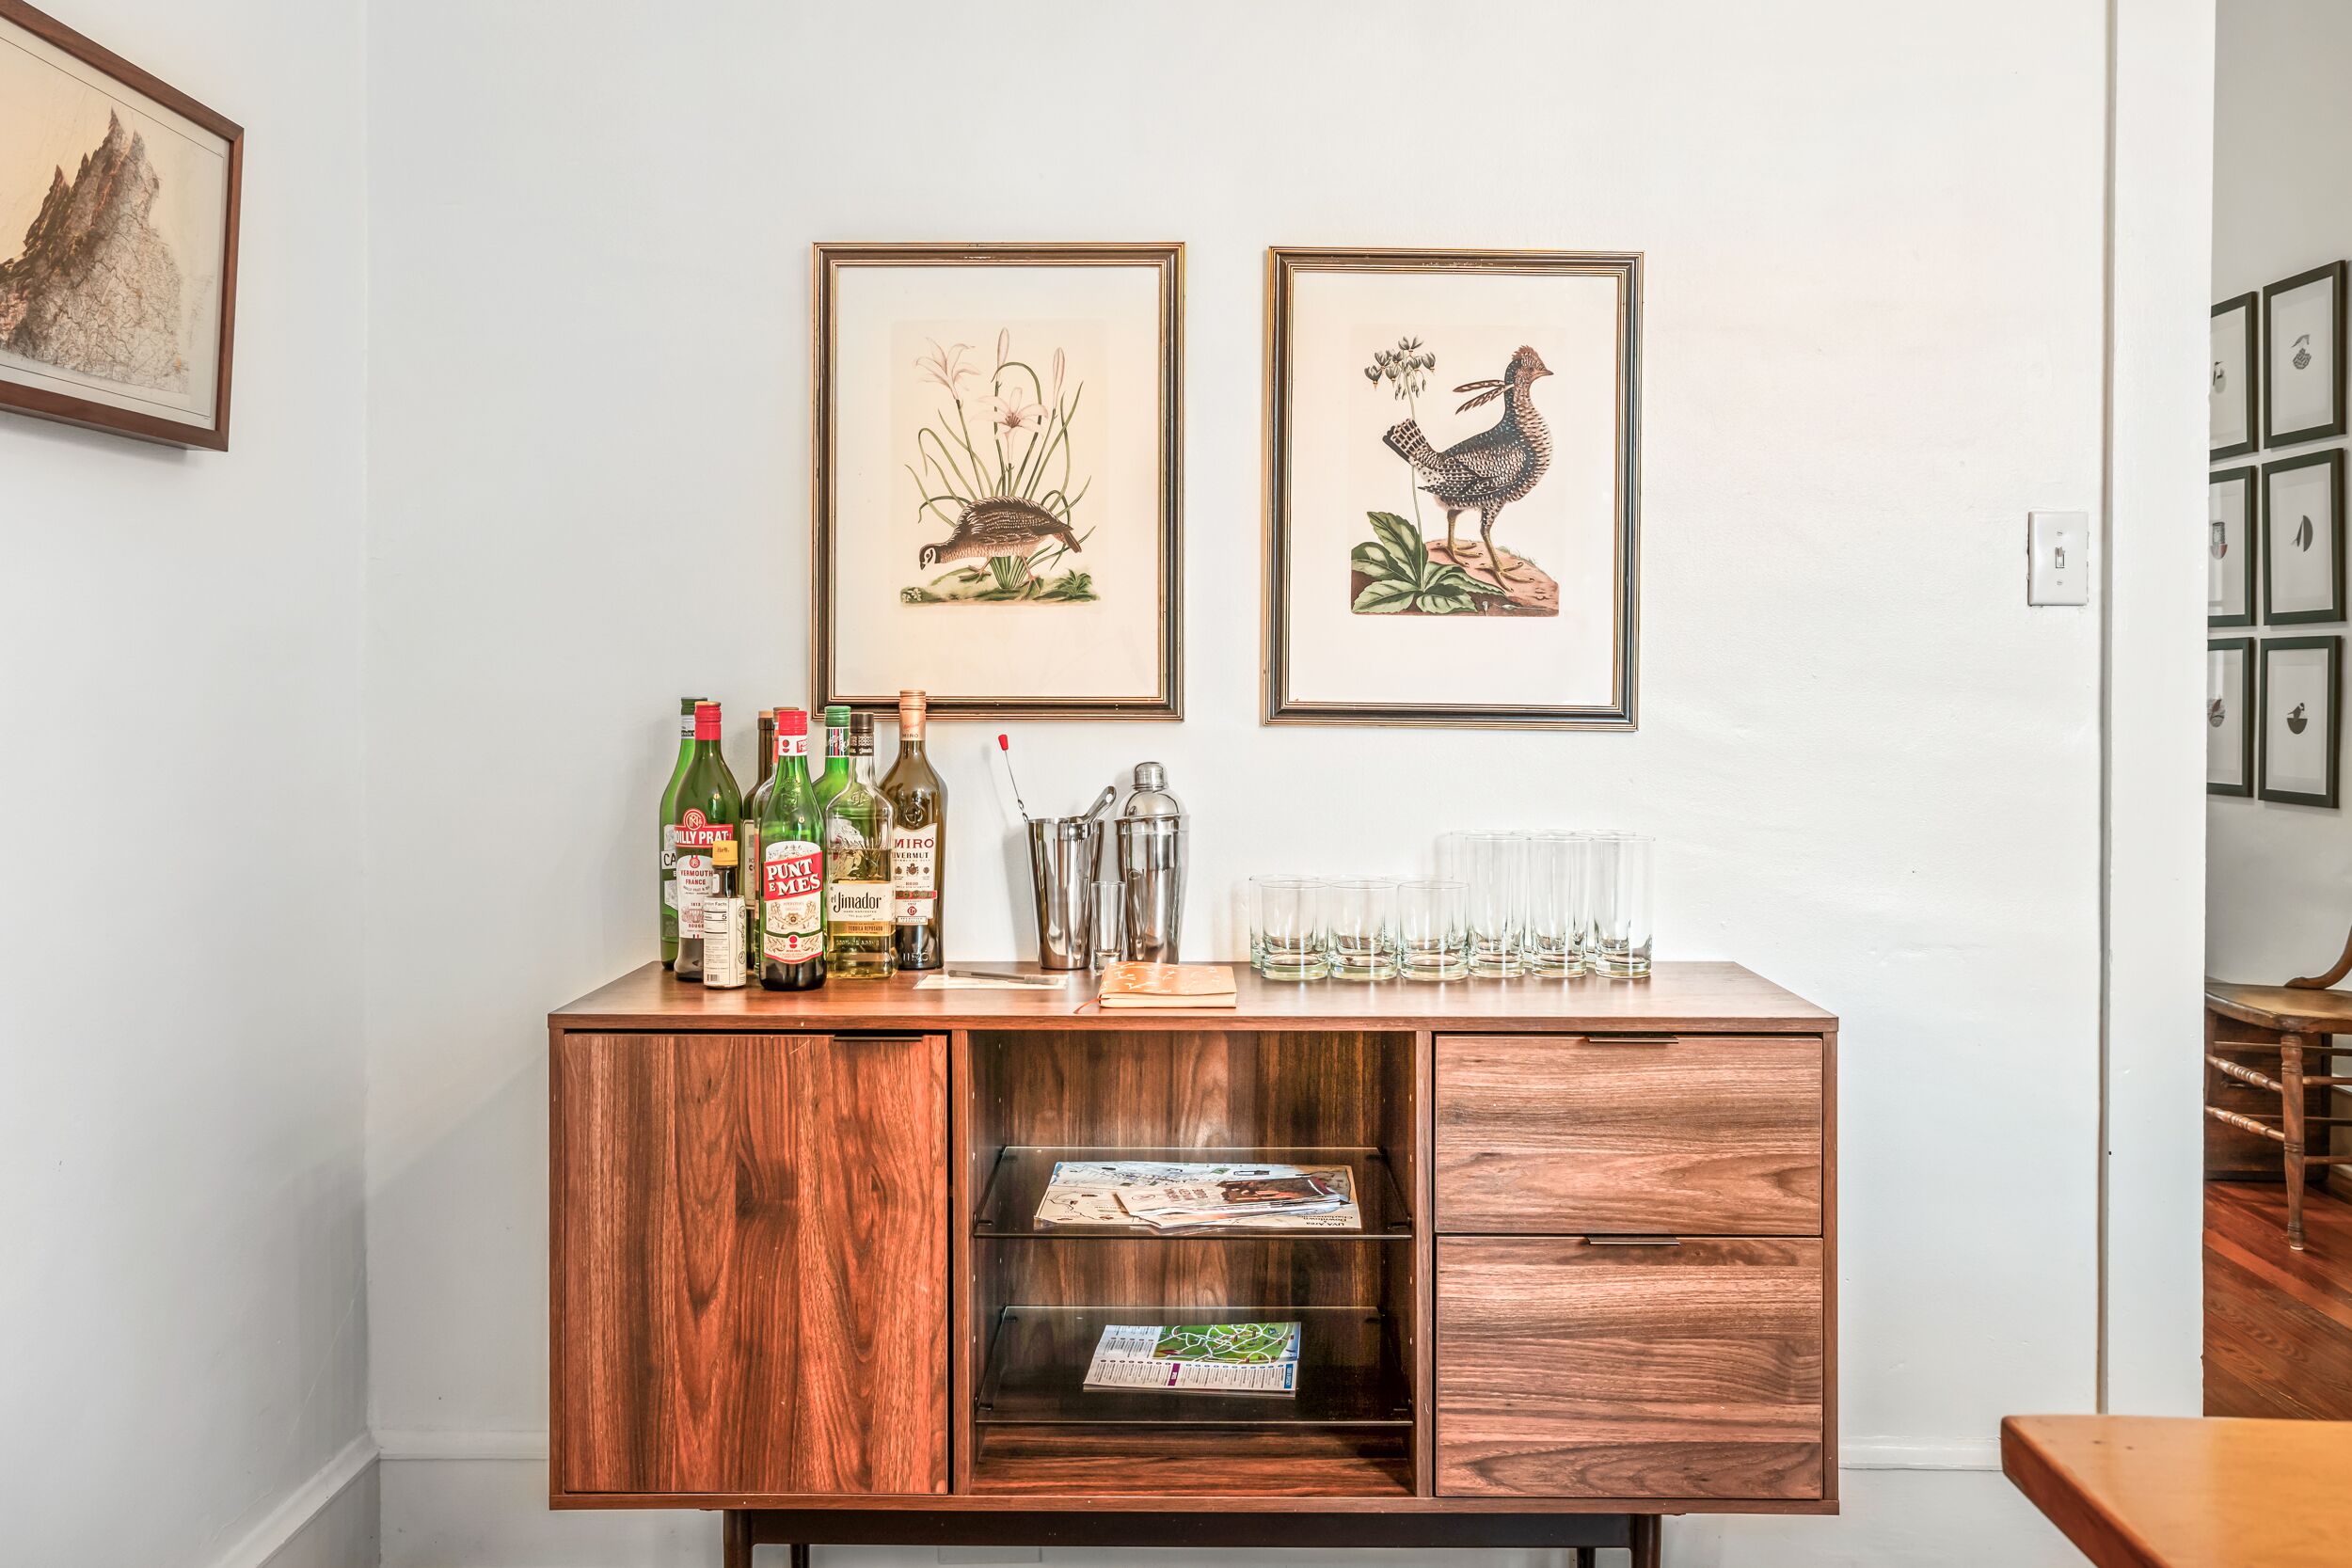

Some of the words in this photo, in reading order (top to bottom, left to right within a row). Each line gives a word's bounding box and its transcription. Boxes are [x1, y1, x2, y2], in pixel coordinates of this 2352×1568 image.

[675, 831, 696, 845] OILLY
[766, 858, 813, 881] PUNT
[769, 882, 776, 893] E
[777, 873, 821, 896] MES
[834, 892, 882, 913] Jimador
